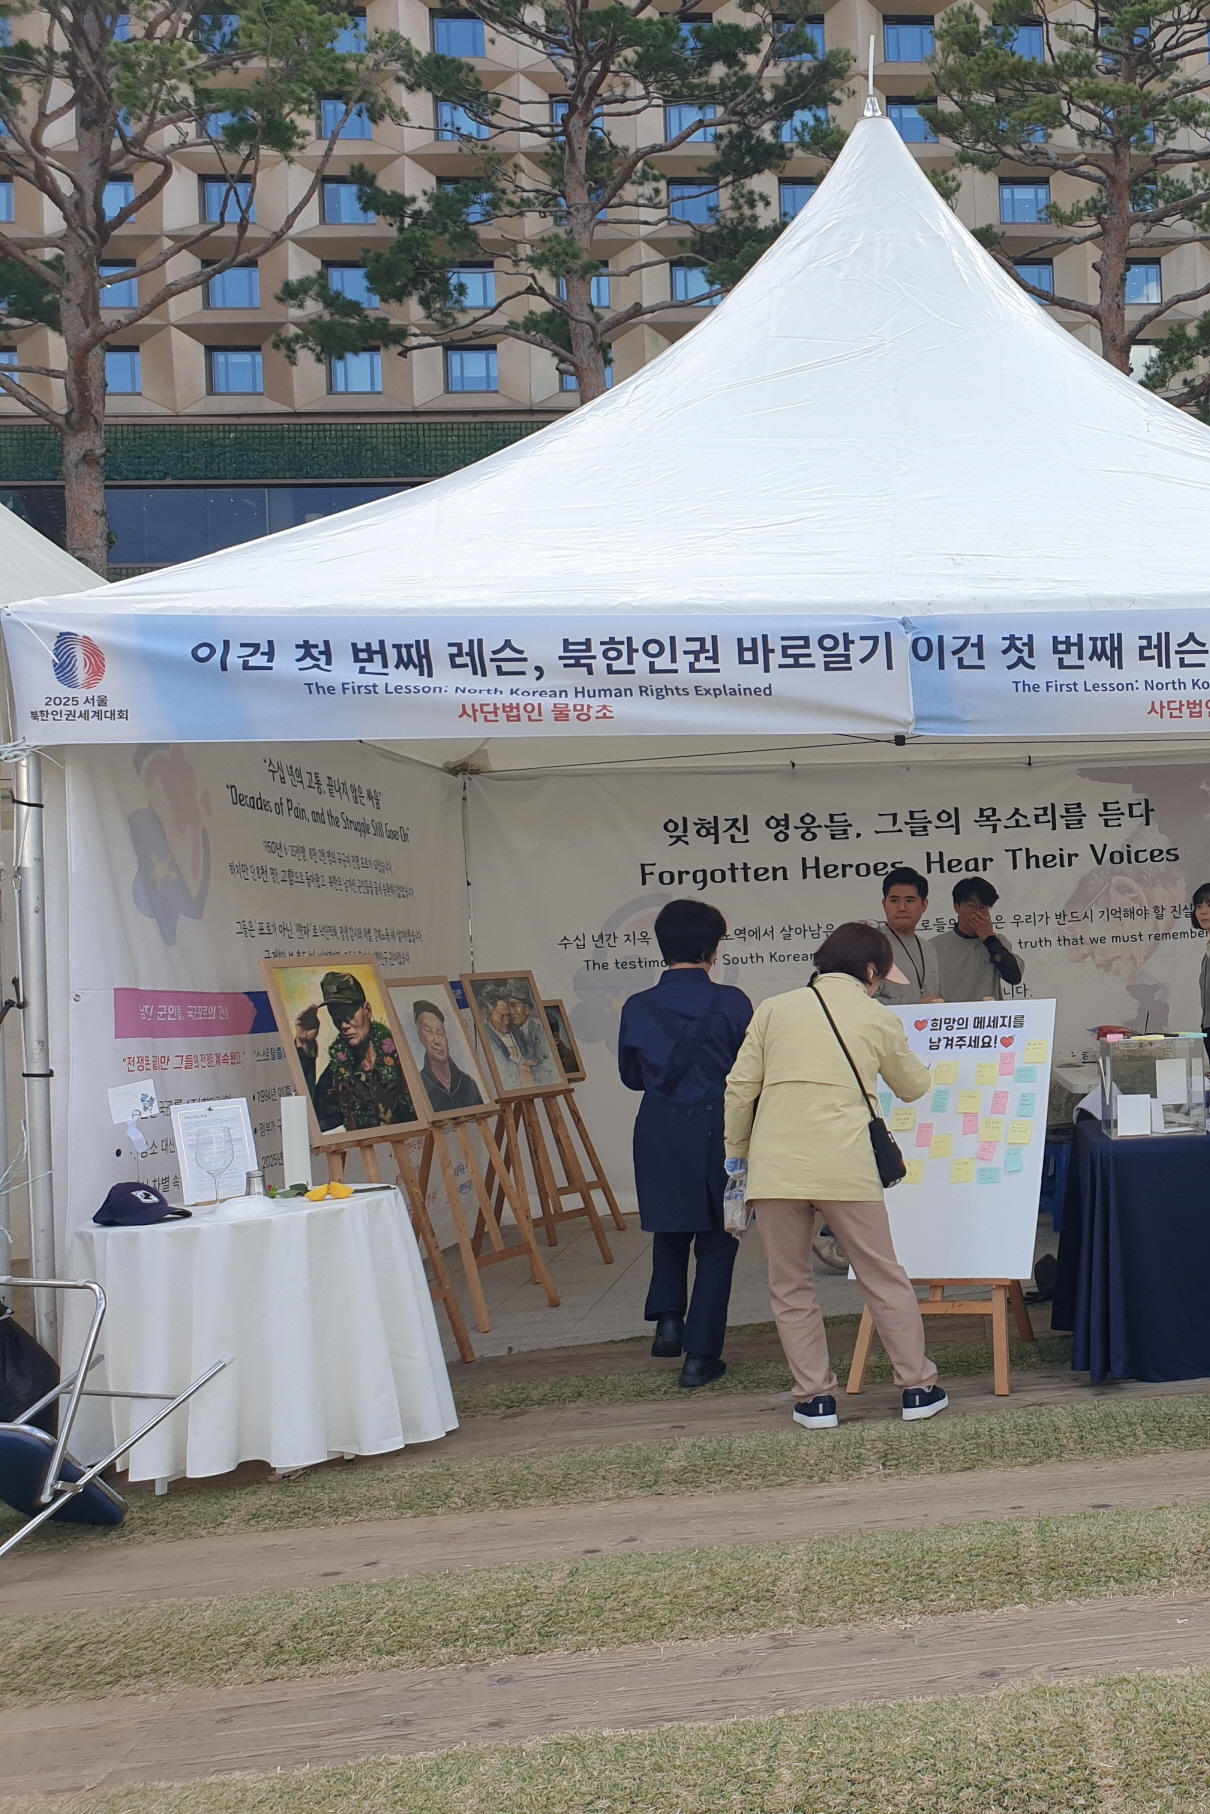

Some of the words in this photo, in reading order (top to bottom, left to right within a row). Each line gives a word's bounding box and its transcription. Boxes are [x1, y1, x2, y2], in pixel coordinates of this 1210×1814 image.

[190, 638, 276, 673] 이건
[294, 638, 335, 673] 첫
[351, 638, 434, 678] 번째
[447, 637, 545, 681] 레슨,
[558, 633, 721, 677] 북한인권
[736, 631, 894, 674] 바로알기
[911, 633, 986, 671] 이건
[1001, 633, 1037, 671] 첫
[1052, 632, 1124, 671] 번째
[304, 682, 337, 695] The
[341, 682, 379, 695] First
[384, 682, 449, 696] Lesson:
[455, 685, 504, 696] North
[509, 685, 569, 699] Korean
[573, 684, 634, 699] Human
[638, 683, 690, 701] Rights
[694, 682, 773, 700] Explained
[1012, 680, 1041, 693] The
[1045, 679, 1079, 693] First
[1083, 679, 1140, 692] Lesson:
[1143, 678, 1187, 691] North
[45, 696, 79, 707] 2025
[83, 694, 109, 708] 서울
[458, 702, 543, 724] 사단법인
[550, 702, 615, 722] 물망초
[30, 708, 129, 722] 북한인권세계대회
[286, 764, 305, 790] 년의
[306, 771, 325, 795] 고통,
[274, 796, 284, 816] of
[287, 797, 310, 824] Pain,
[311, 807, 326, 825] and
[327, 808, 340, 828] the
[341, 812, 371, 839] Struggle
[371, 818, 385, 838] Still
[385, 822, 400, 842] Goes
[662, 814, 750, 847] 잊혀진
[764, 811, 862, 843] 영웅들,
[874, 806, 961, 837] 그들의
[973, 801, 1088, 833] 목소리를
[1097, 797, 1155, 829] 듣다
[639, 860, 789, 891] Forgotten
[925, 850, 994, 874] Hear
[1004, 845, 1080, 870] Their
[1088, 843, 1180, 866] Voices
[236, 919, 256, 938] 그들은
[278, 921, 294, 939] 아닌
[557, 932, 586, 950] 수십
[591, 932, 619, 949] 년간
[1010, 910, 1051, 928] 우리가
[1054, 908, 1094, 926] 반드시
[1098, 905, 1149, 924] 기억해야
[1152, 904, 1167, 921] 할
[583, 959, 609, 971] The
[722, 952, 764, 966] South
[1018, 936, 1052, 950] truth
[1056, 934, 1085, 947] that
[1088, 934, 1107, 945] we
[1111, 931, 1144, 943] must
[1147, 927, 1209, 942] remember
[929, 1016, 969, 1032] 희망의
[972, 1013, 1026, 1029] 메세지를
[928, 1034, 998, 1051] 남겨주세요!
